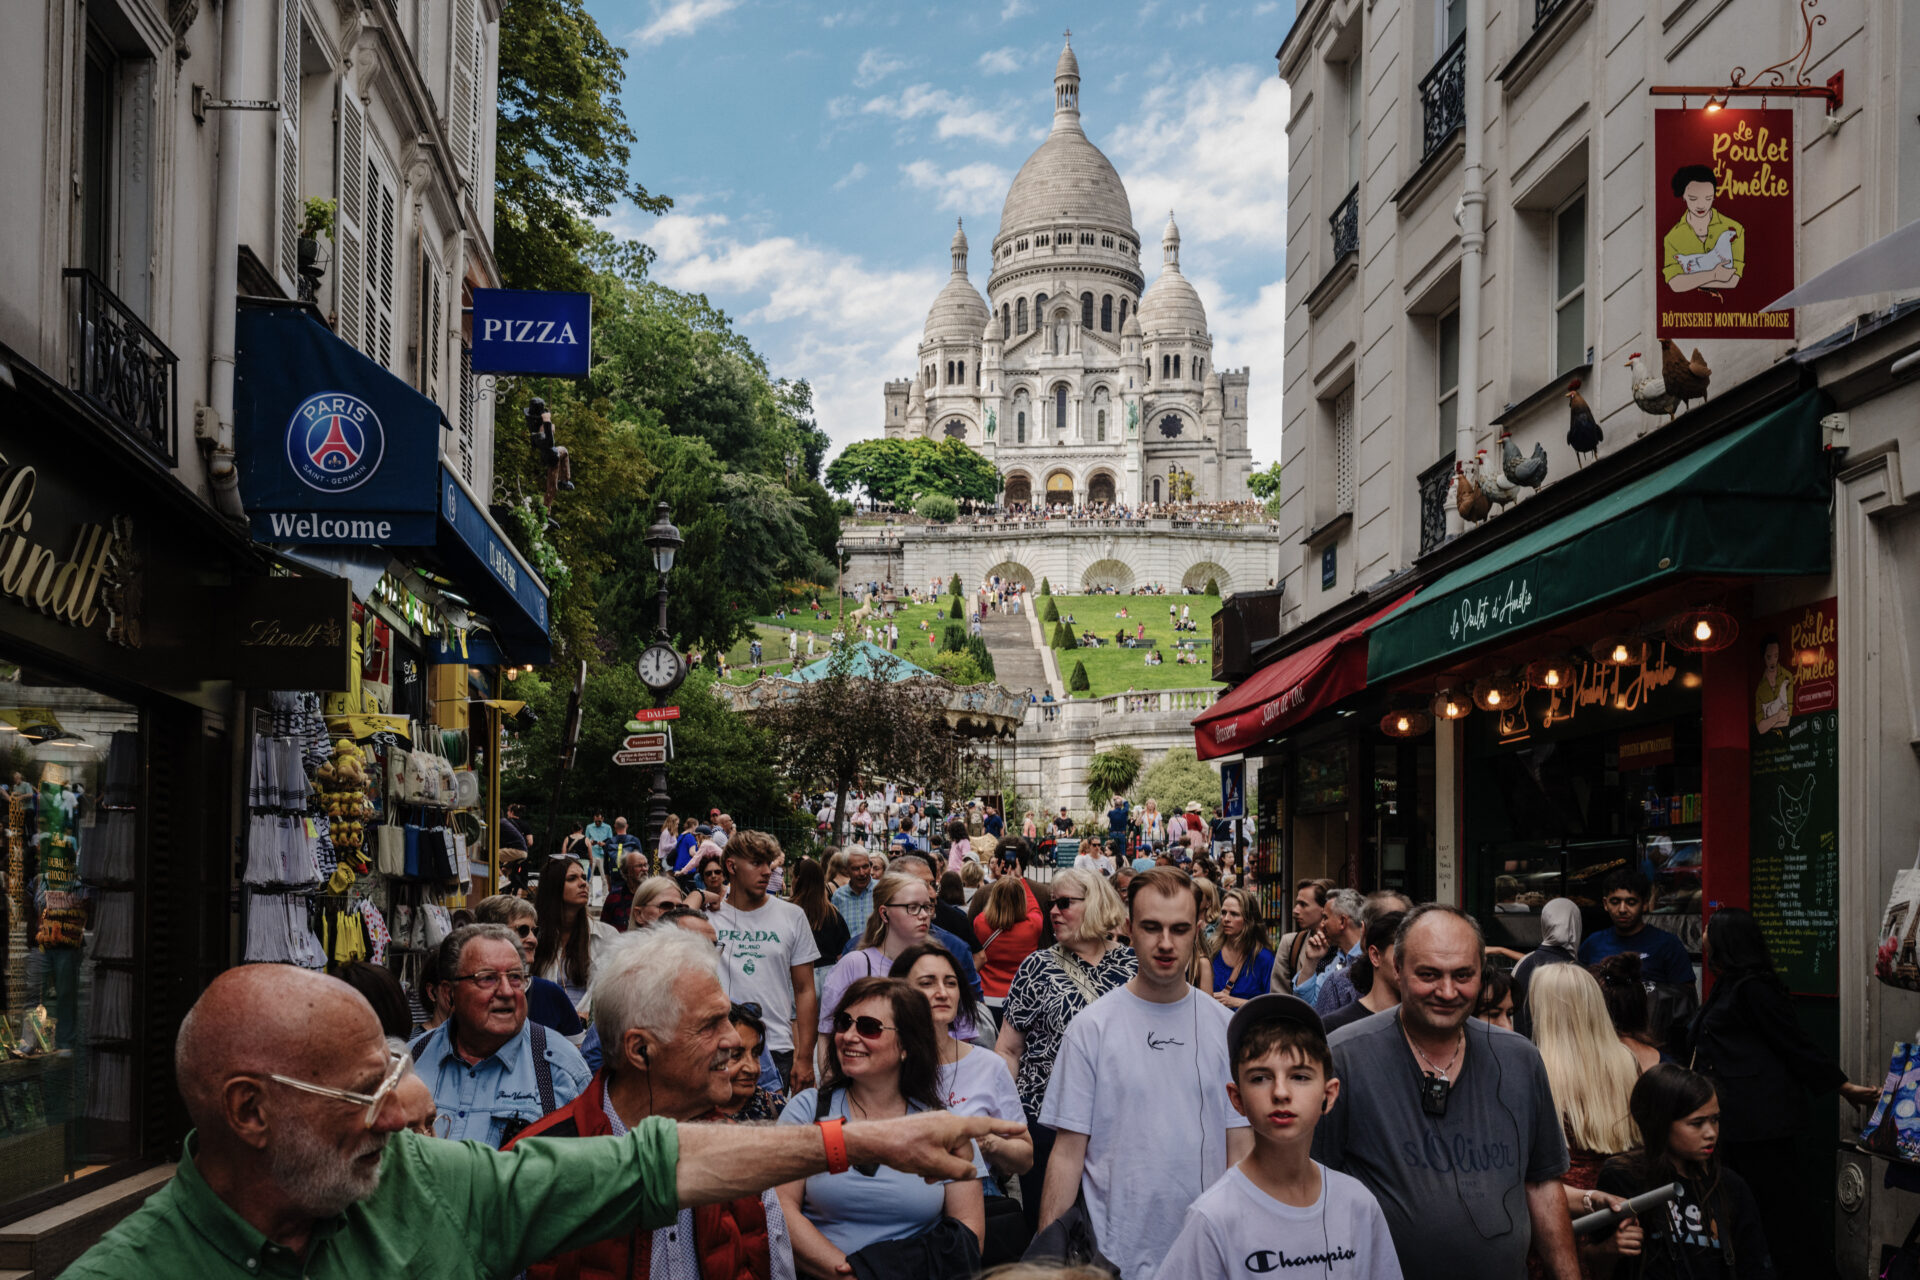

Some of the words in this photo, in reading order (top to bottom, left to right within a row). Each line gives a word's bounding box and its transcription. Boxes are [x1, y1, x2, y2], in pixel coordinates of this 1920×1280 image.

[1712, 127, 1789, 162] Poulet
[1733, 120, 1753, 141] Le
[1716, 163, 1789, 199] Amélie
[482, 318, 578, 345] PIZZA
[1662, 310, 1712, 328] RÔTISSERIE
[1714, 312, 1789, 328] MONTMARTROISE
[303, 398, 367, 423] PARIS
[269, 512, 392, 540] Welcome
[1461, 596, 1489, 642] Poulet
[1791, 611, 1835, 651] Poulet
[1801, 608, 1814, 629] Le
[240, 619, 322, 648] Lindt
[718, 929, 781, 943] PRADA
[1403, 1129, 1515, 1173] s.Oliver
